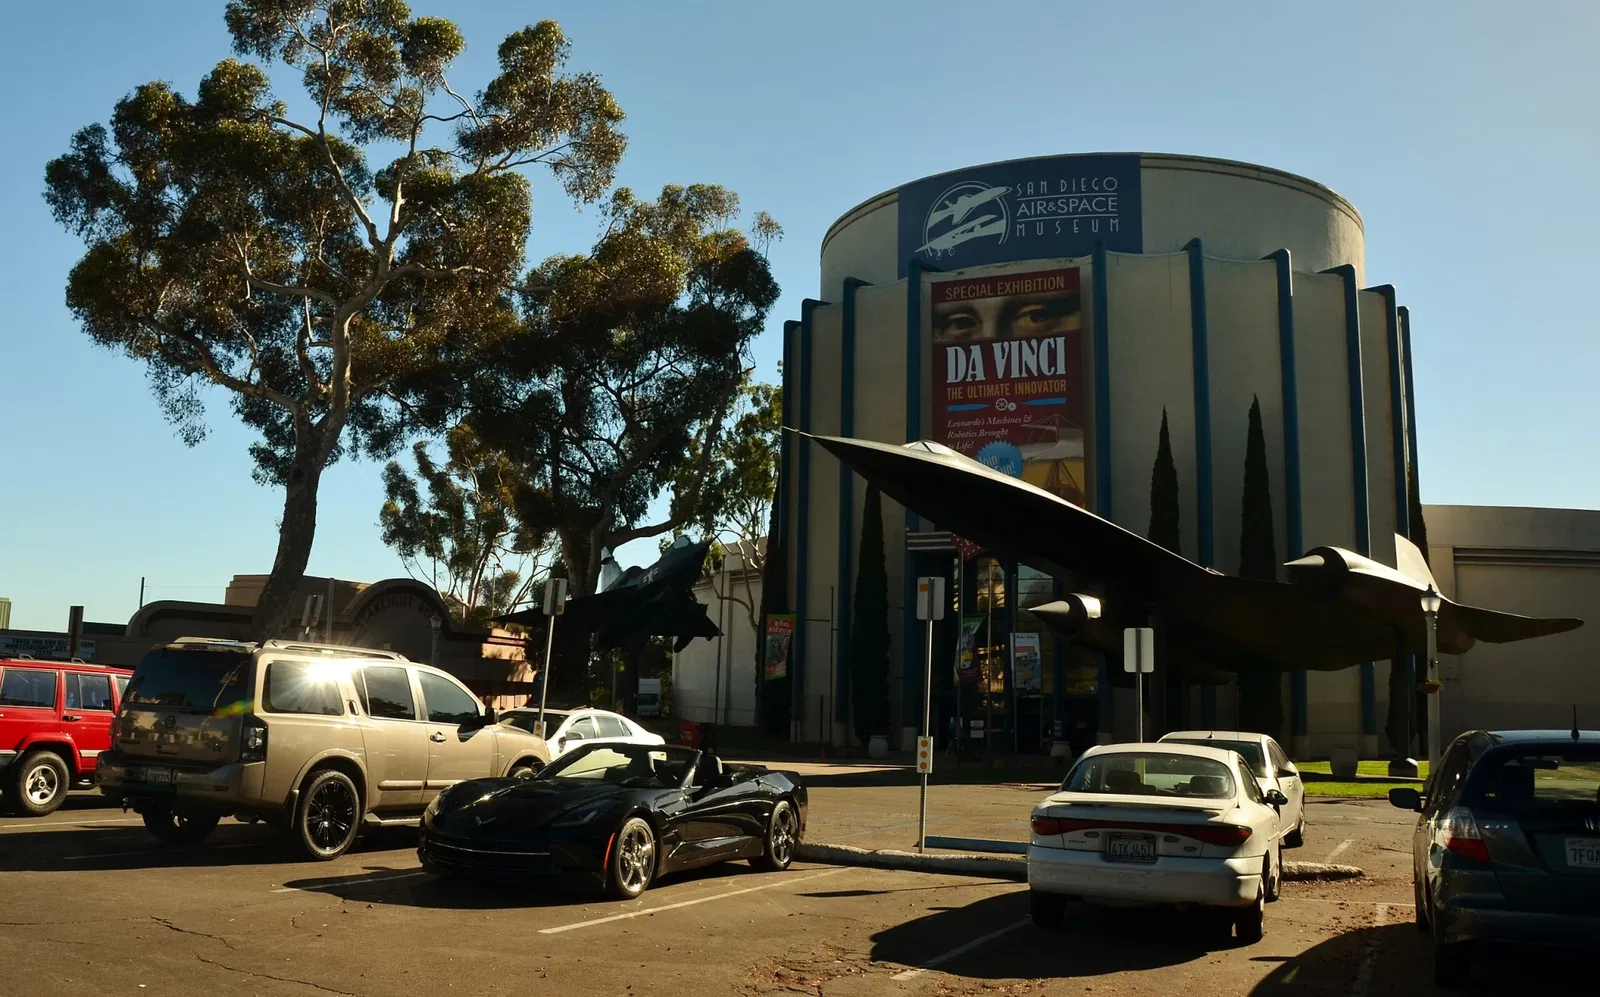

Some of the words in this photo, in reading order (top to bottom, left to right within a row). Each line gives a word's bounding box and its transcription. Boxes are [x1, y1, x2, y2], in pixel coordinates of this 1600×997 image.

[1016, 180, 1047, 197] SAN
[1060, 177, 1118, 193] DIEGO
[1016, 197, 1118, 217] AIR&SPACE
[1016, 218, 1119, 237] MUSEUM
[945, 283, 994, 301] SPECIAL
[997, 275, 1065, 296] EXHIBITION
[945, 344, 987, 384] DA
[991, 336, 1067, 380] VINCI
[946, 386, 964, 401] THE
[967, 382, 1011, 399] ULTIMATE
[1014, 379, 1067, 396] INNOVATOR
[947, 418, 985, 428] Leonardo's
[986, 416, 1021, 425] Machines
[1023, 414, 1032, 423] &
[947, 431, 977, 439] Robotics
[978, 428, 1009, 438] Brought
[956, 441, 974, 451] Life!
